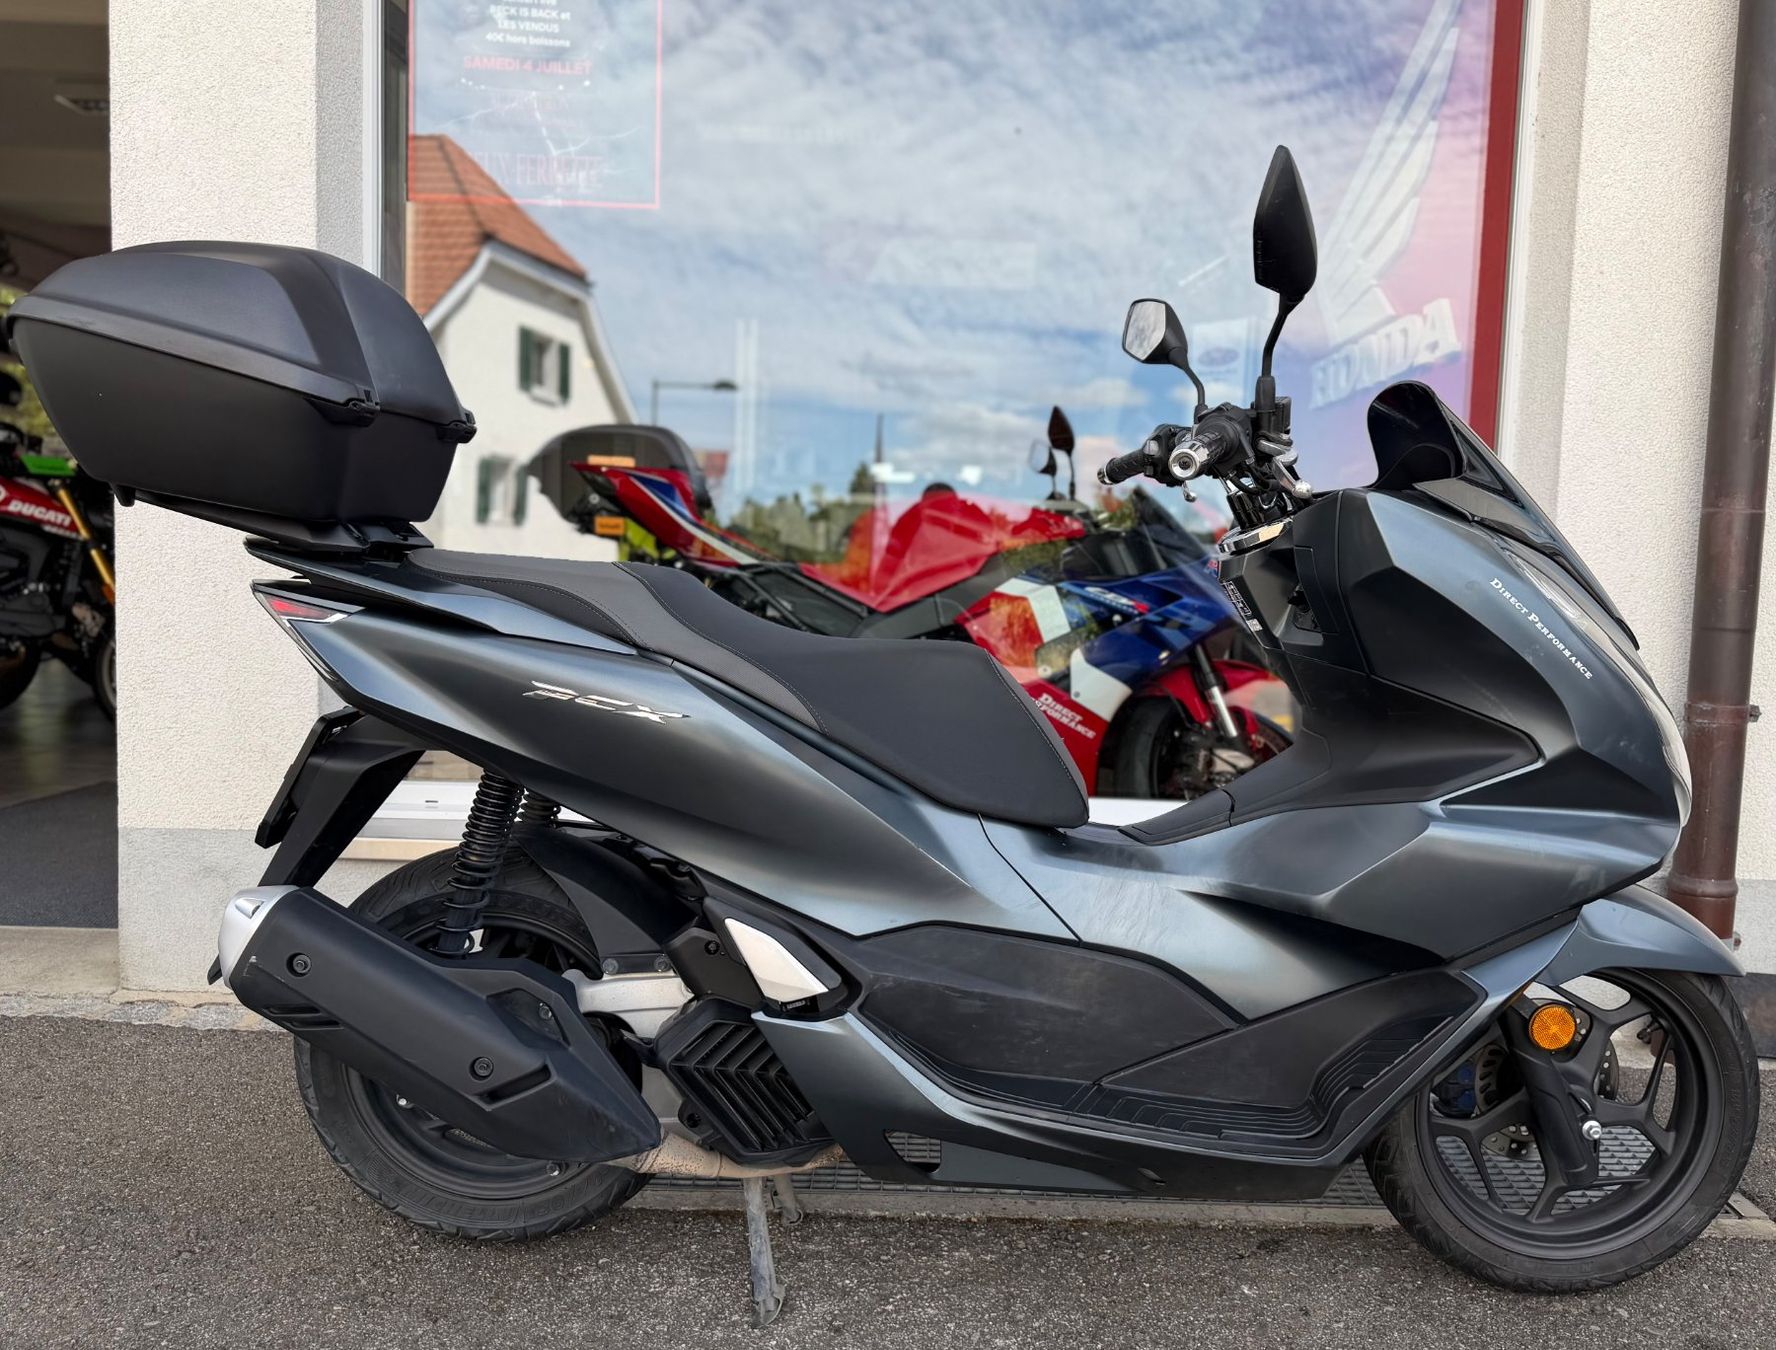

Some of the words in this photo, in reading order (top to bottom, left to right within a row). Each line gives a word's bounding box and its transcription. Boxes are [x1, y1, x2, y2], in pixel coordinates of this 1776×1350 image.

[531, 8, 559, 19] BACK
[518, 20, 560, 33] VENDUS
[464, 55, 520, 71] SAMEDI
[521, 59, 533, 71] 4
[535, 59, 593, 75] JUILLET
[1310, 297, 1462, 410] HONDA
[8, 499, 72, 527] DUCATI
